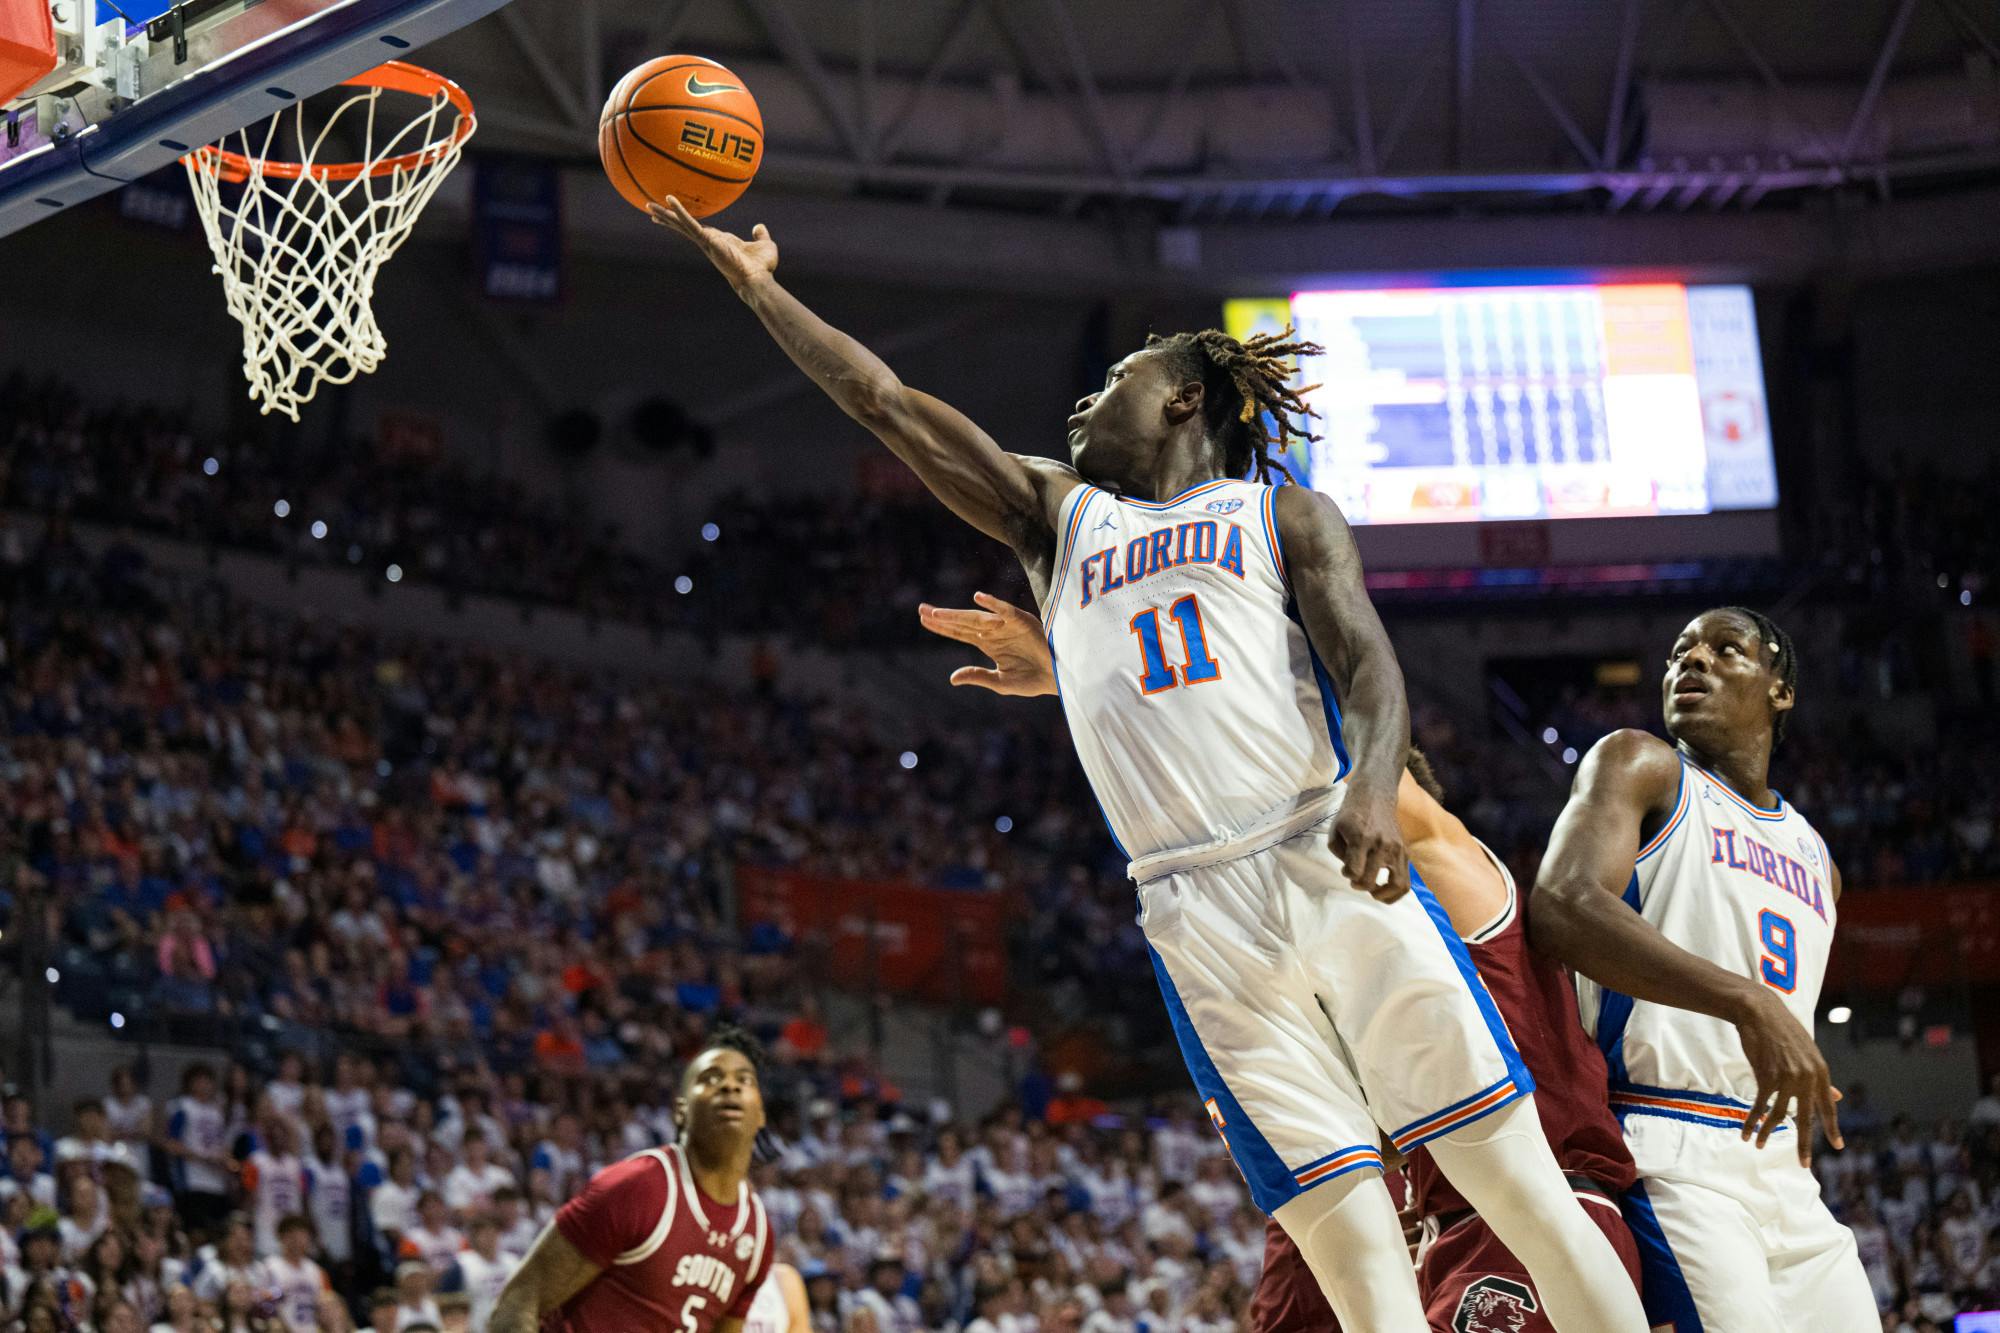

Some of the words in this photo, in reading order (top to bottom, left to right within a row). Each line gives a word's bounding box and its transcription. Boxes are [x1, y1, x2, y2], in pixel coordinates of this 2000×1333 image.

[681, 120, 756, 163] ELITE
[1080, 520, 1245, 610] FLORIDA
[1130, 593, 1222, 695] 11
[1758, 907, 1798, 995] 9
[672, 1253, 736, 1304] SOUTH
[673, 1294, 707, 1333] 5
